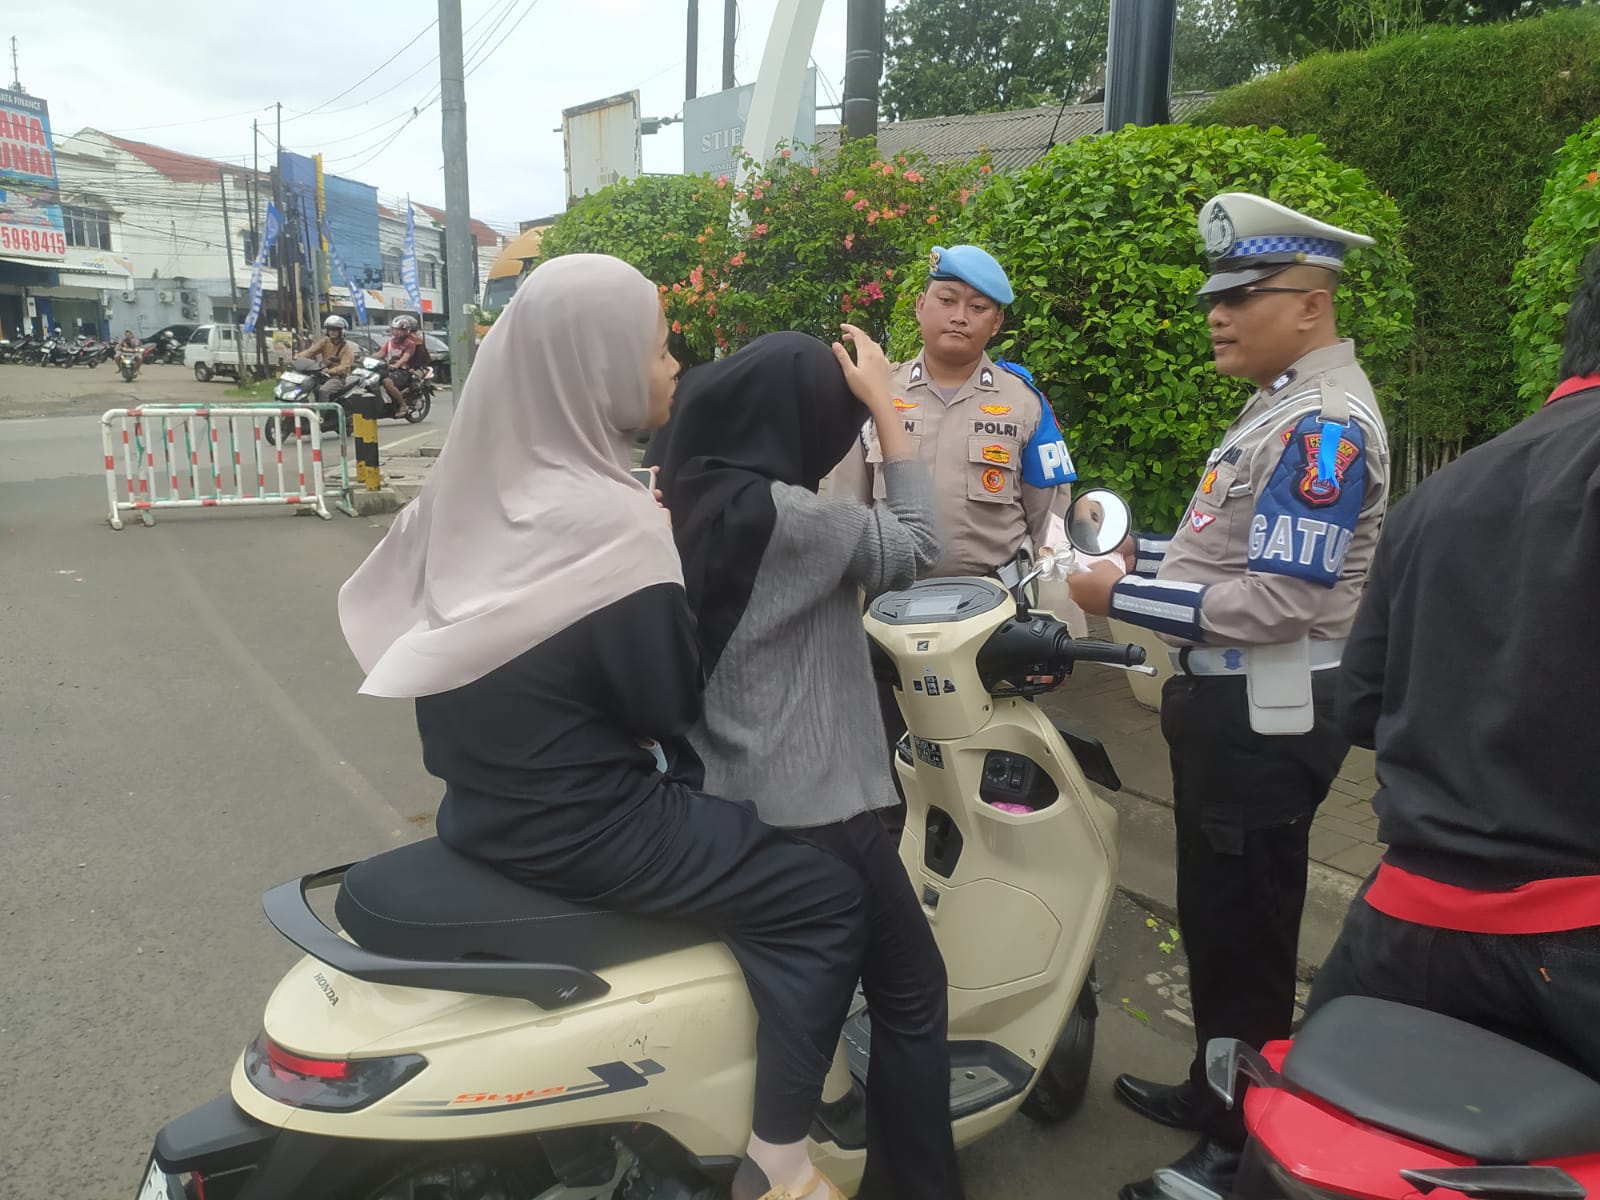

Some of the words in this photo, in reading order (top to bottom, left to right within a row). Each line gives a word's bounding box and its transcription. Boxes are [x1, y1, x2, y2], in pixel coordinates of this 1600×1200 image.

[701, 127, 741, 153] STIE
[974, 421, 1018, 438] POLRI
[1248, 514, 1354, 577] GATU
[313, 972, 339, 1007] HONDA
[454, 1085, 565, 1105] Style
